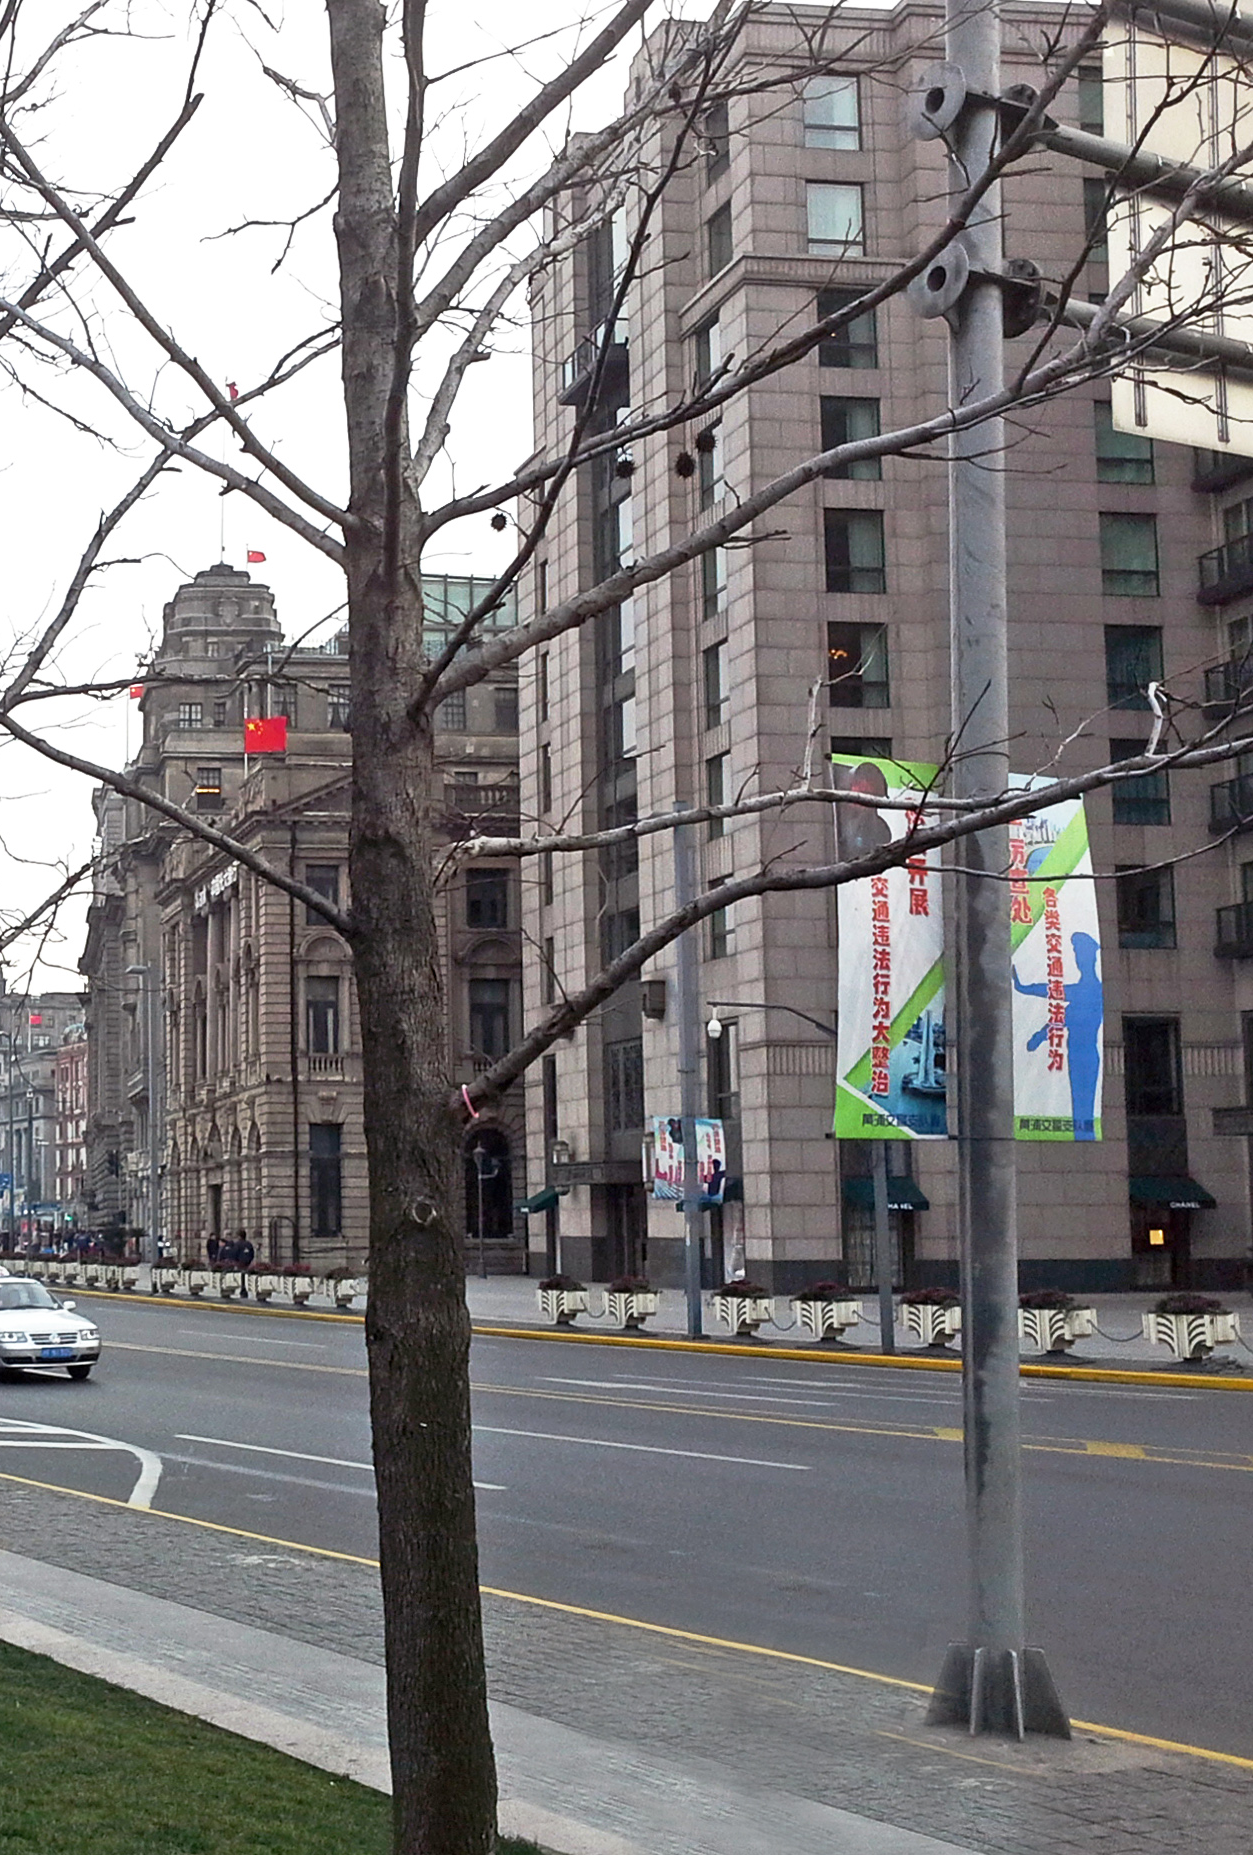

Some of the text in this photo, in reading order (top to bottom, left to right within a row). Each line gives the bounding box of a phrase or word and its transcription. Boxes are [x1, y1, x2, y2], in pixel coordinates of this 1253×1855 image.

[1009, 818, 1033, 924] 厉查处
[871, 876, 891, 1094] 交通违法行为大整治
[1043, 886, 1065, 1072] 各类交通违法行为
